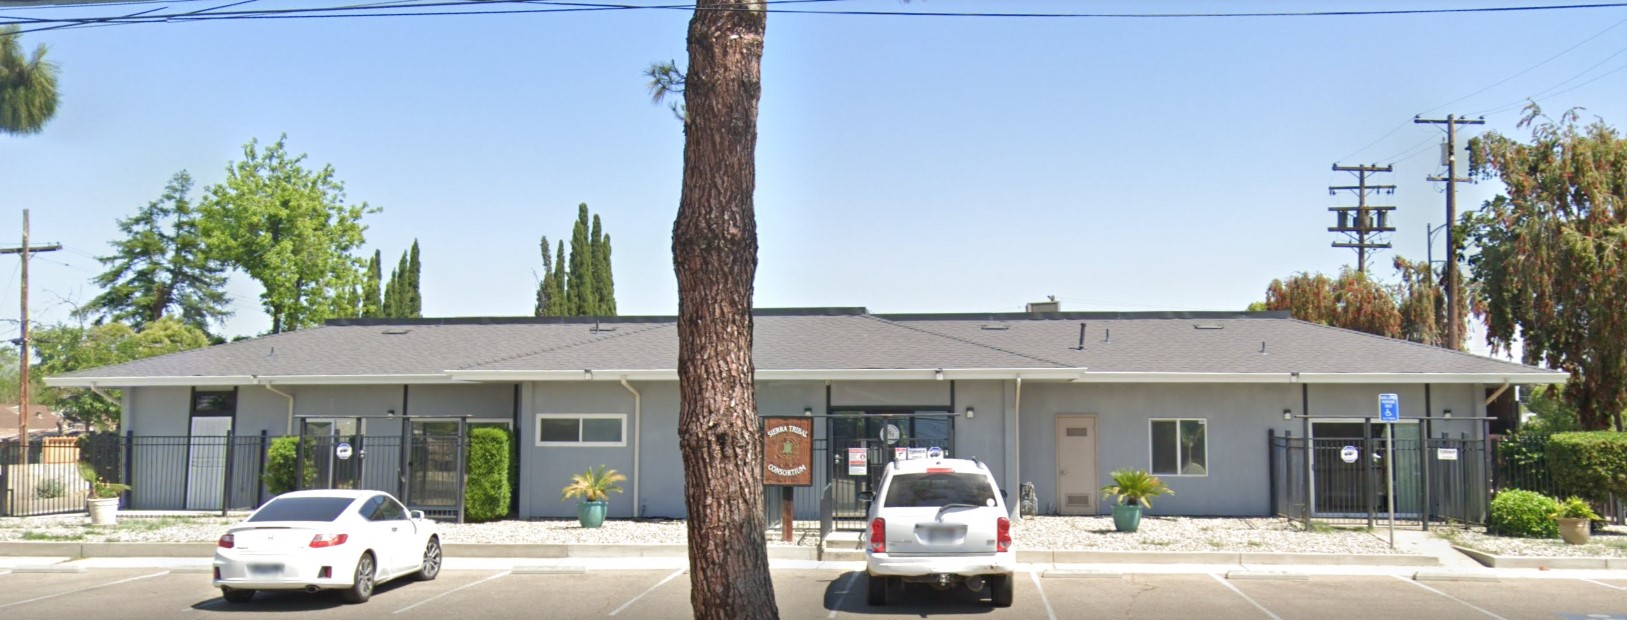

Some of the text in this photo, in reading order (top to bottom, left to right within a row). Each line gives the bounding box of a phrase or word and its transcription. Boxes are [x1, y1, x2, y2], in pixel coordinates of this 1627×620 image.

[767, 425, 808, 438] SIERRA TRIBAL
[767, 463, 807, 476] CONSORTIUM
